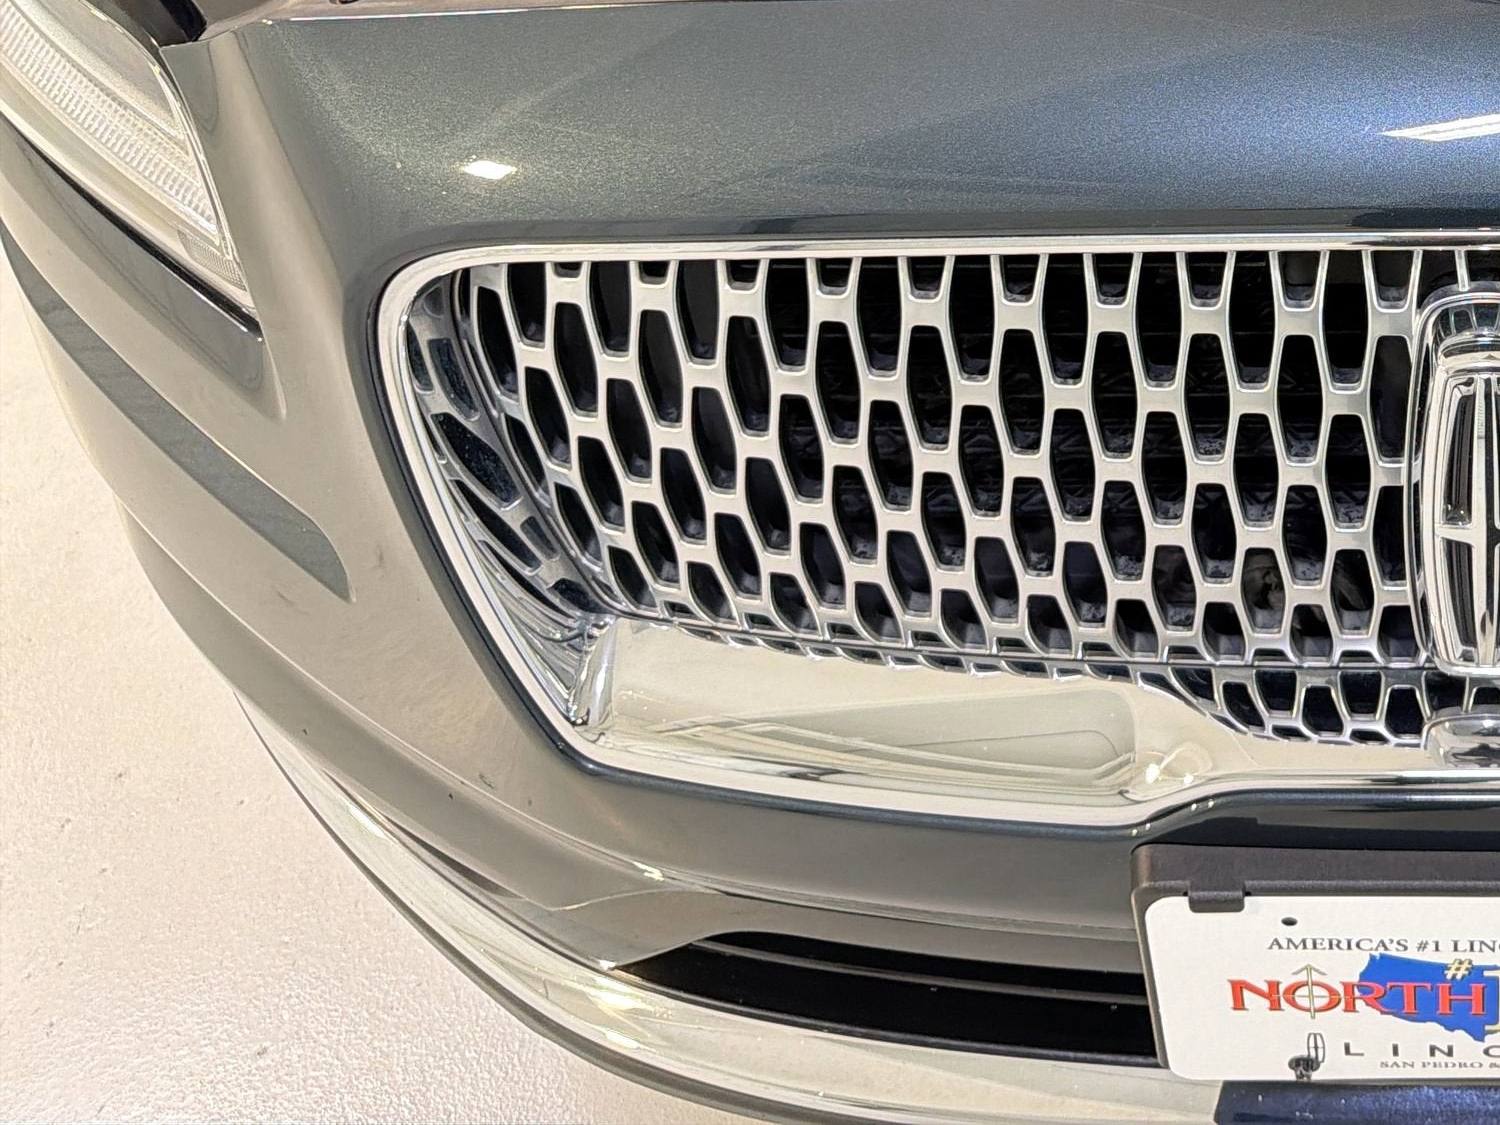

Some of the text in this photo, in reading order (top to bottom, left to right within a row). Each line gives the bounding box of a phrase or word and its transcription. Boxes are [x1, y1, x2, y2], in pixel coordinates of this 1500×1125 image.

[1415, 940, 1440, 953] #1
[1227, 978, 1487, 1016] NORTH
[1380, 1061, 1415, 1069] SAN
[1421, 1061, 1484, 1069] PEDRO
